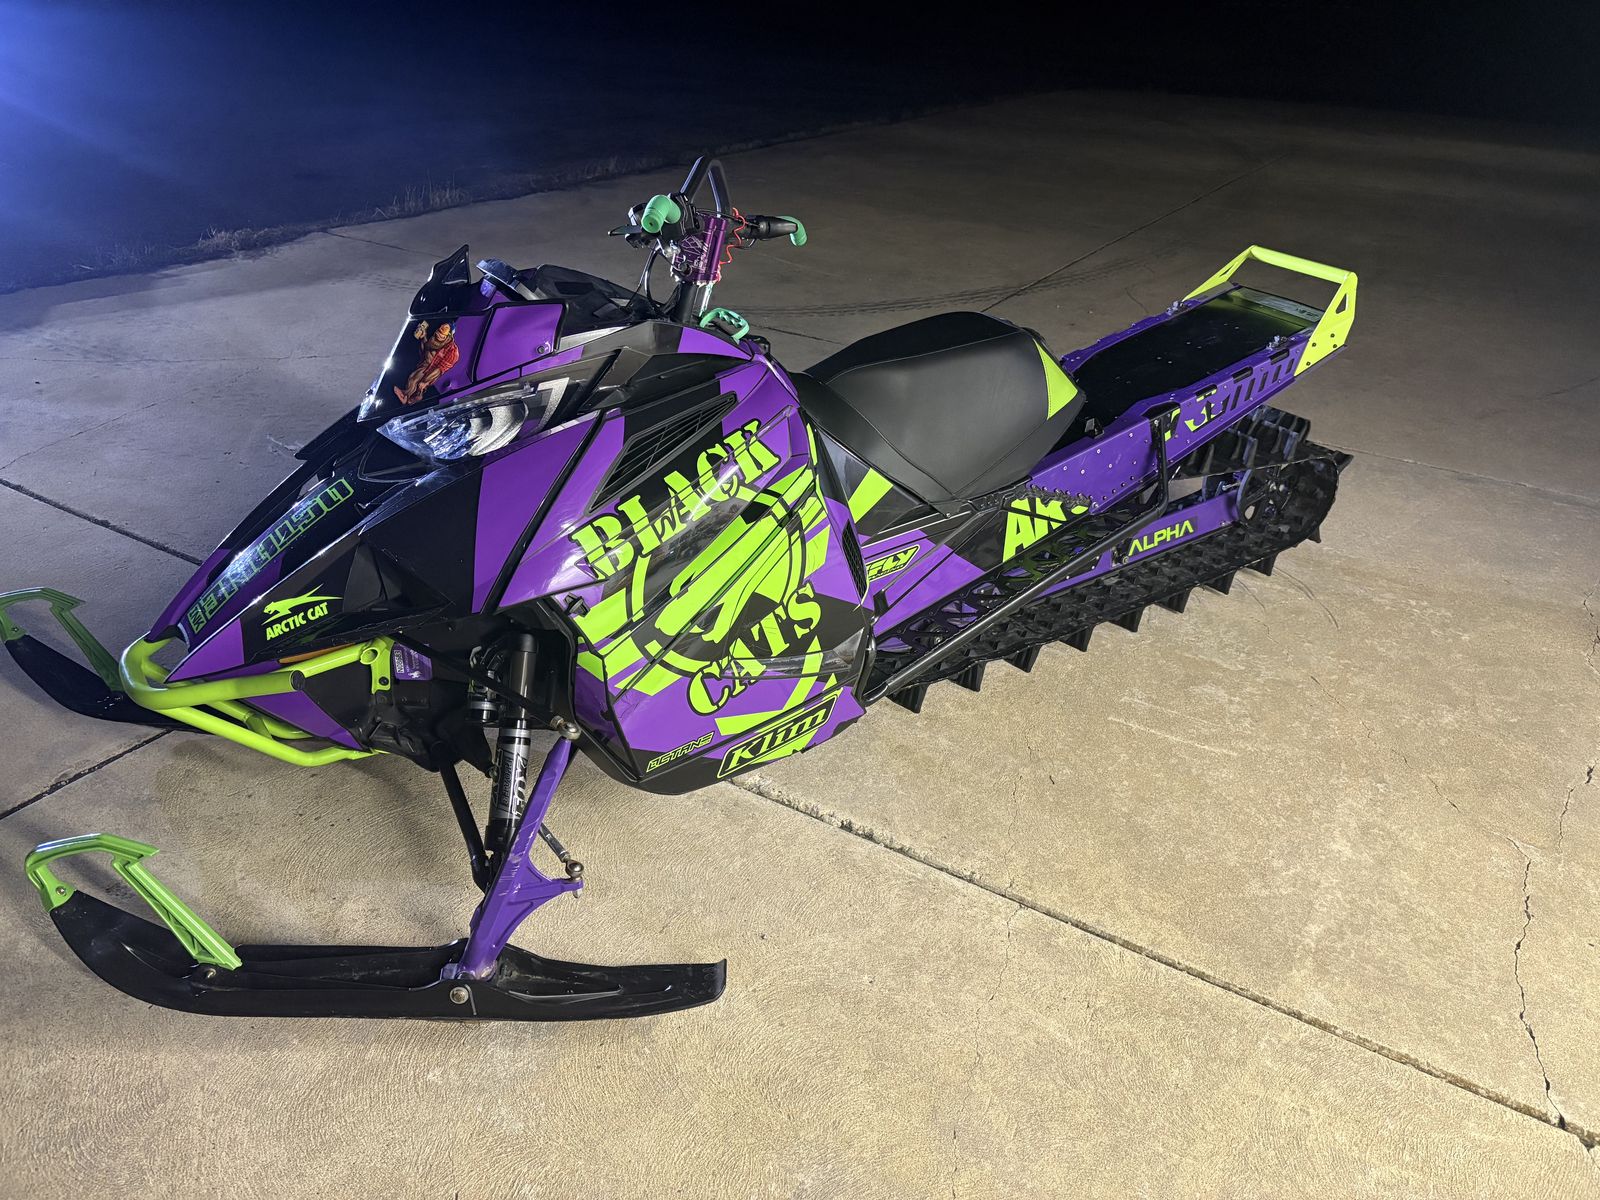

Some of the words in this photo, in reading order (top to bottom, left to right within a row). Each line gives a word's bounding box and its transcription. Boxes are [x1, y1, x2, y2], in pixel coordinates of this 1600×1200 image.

[570, 420, 780, 581] BLACK
[1128, 519, 1195, 557] ALPHA
[265, 612, 307, 641] ARCTIC
[307, 602, 329, 621] CAT
